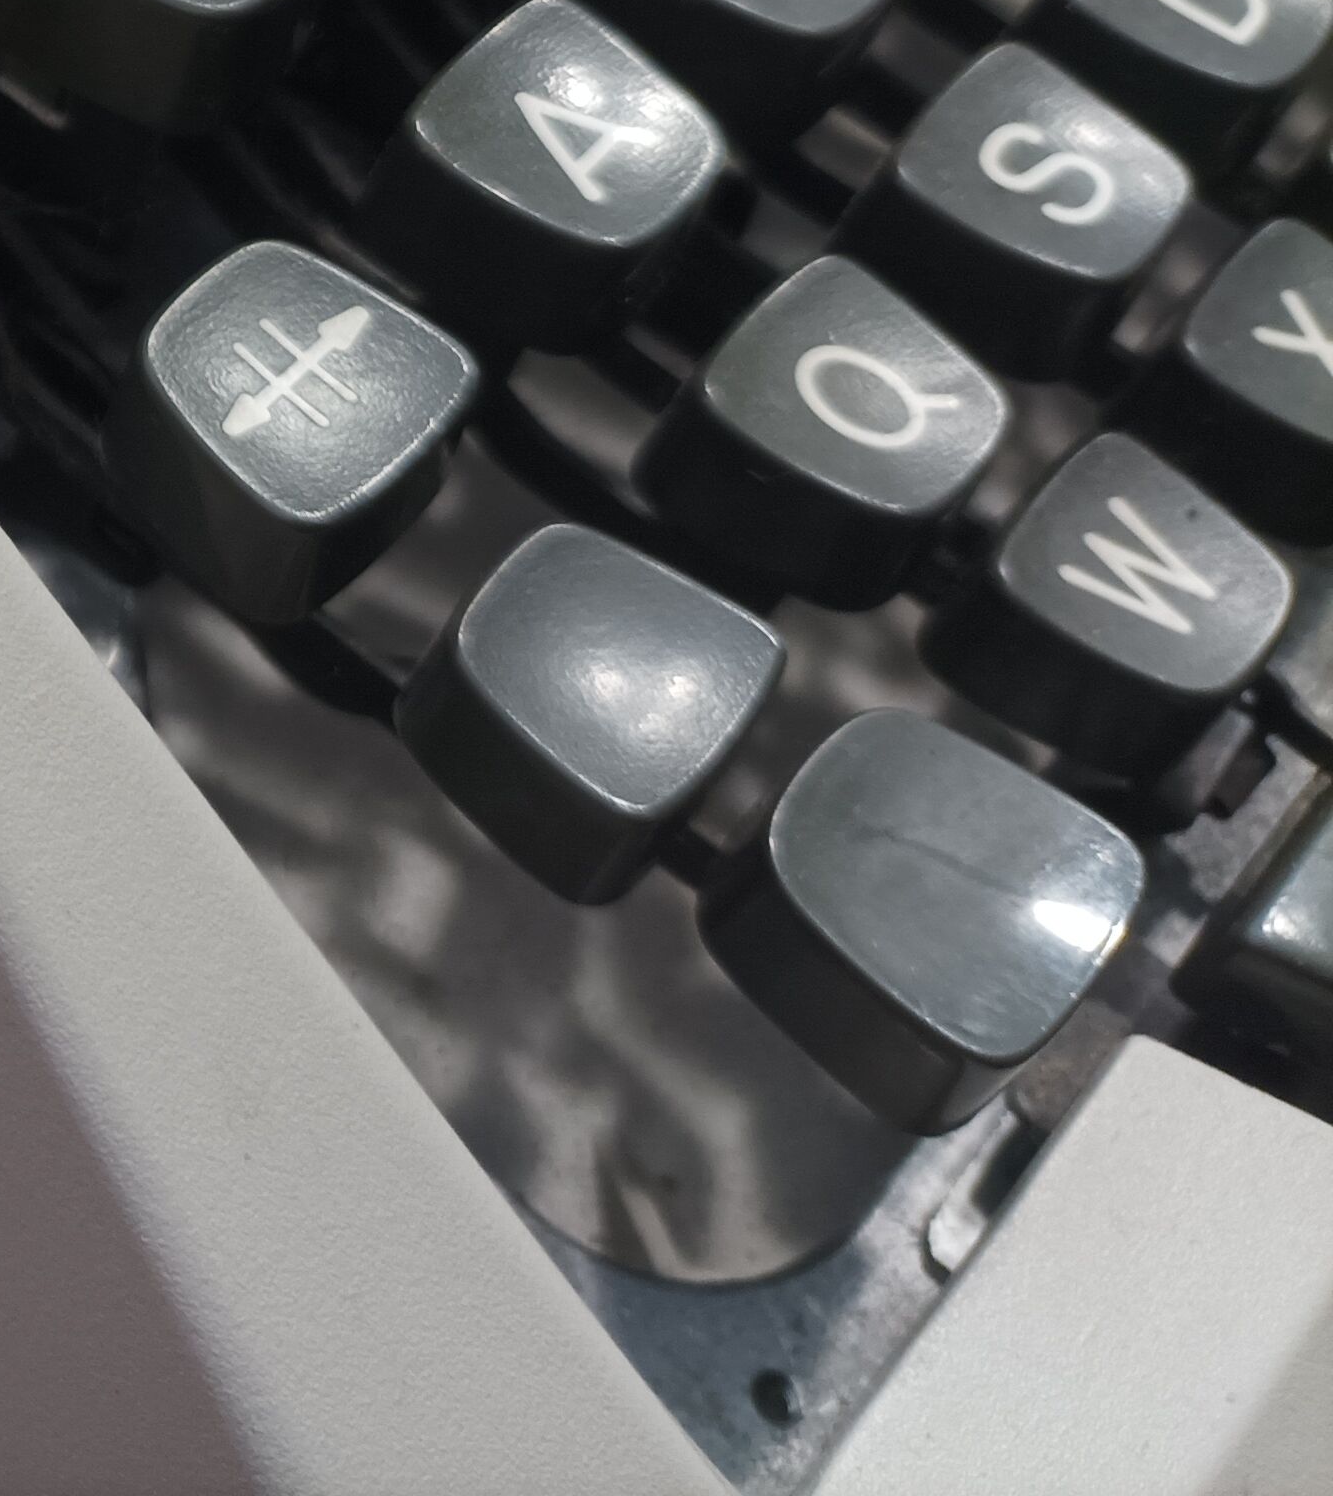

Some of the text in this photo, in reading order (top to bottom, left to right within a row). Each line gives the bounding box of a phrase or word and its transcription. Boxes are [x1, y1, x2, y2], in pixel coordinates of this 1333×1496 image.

[513, 90, 659, 204] A
[978, 122, 1117, 225] S
[794, 343, 961, 450] Q
[1057, 495, 1220, 635] W
